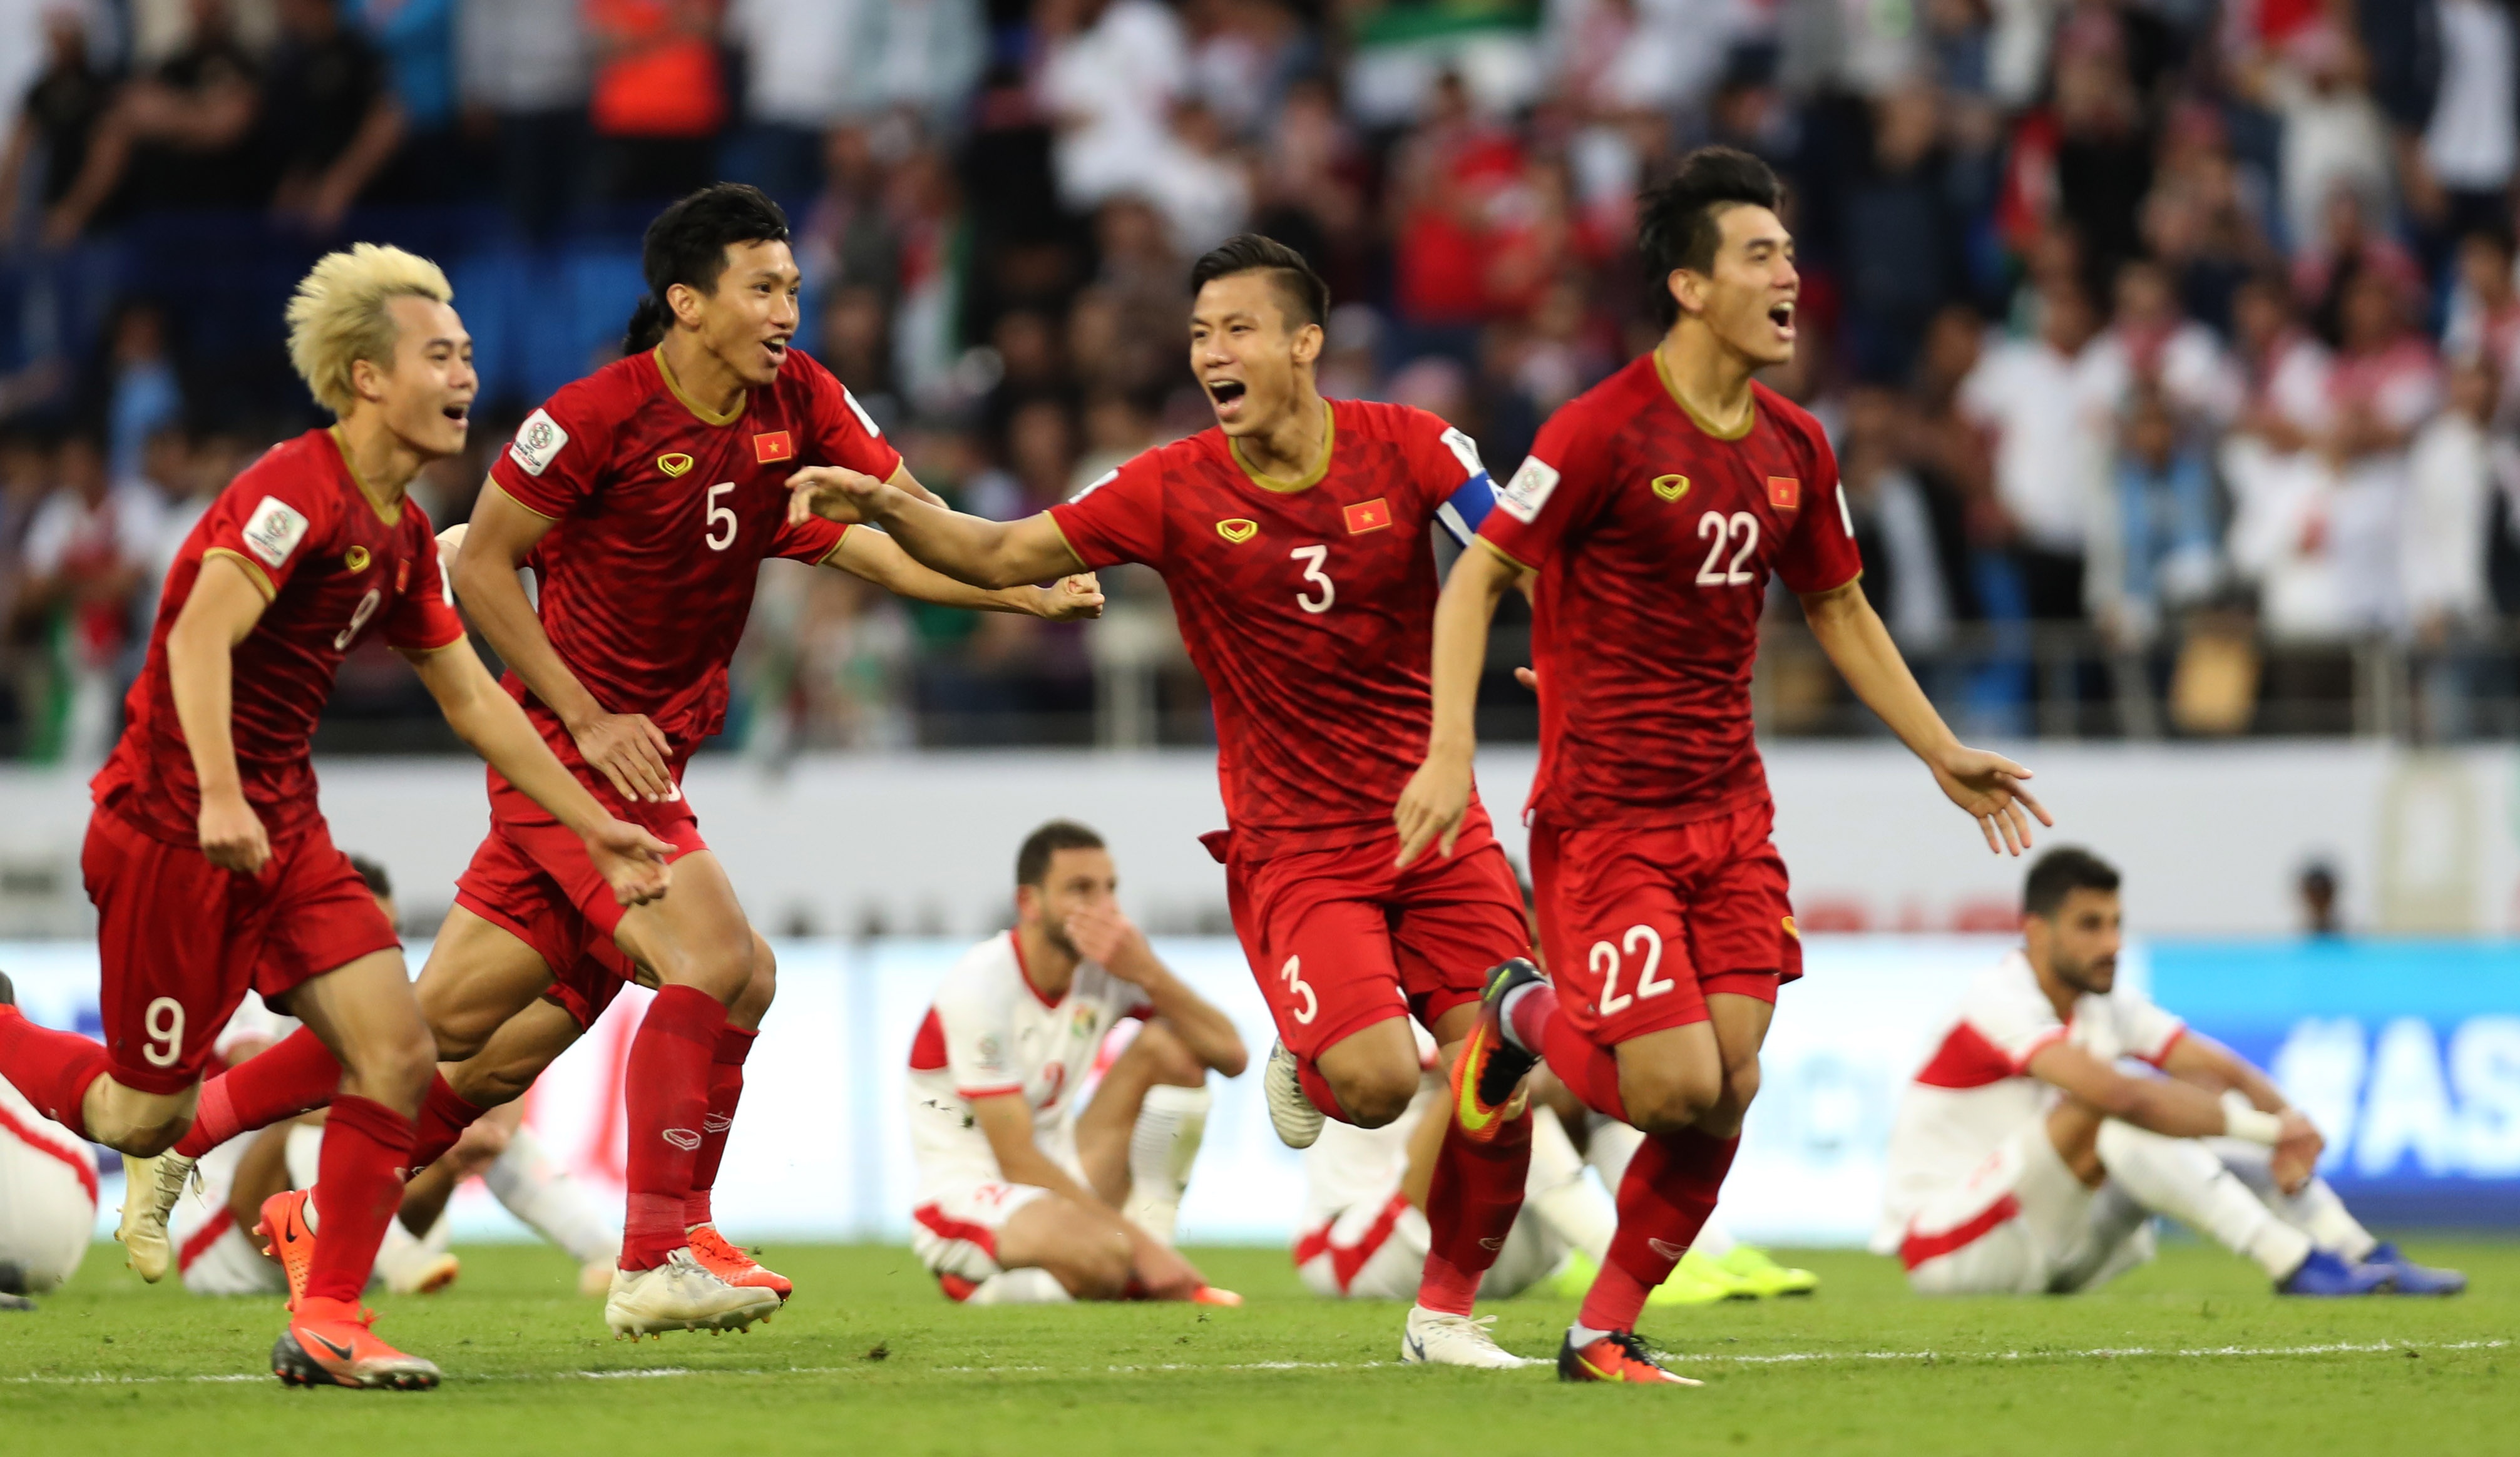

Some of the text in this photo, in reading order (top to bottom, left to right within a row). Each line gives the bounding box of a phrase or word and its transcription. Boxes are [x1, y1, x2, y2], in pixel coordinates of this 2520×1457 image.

[705, 481, 738, 551] 5
[1695, 511, 1759, 586] 22
[1290, 544, 1335, 614] 3
[334, 588, 381, 651] 9
[1281, 954, 1318, 1025] 3
[1588, 924, 1674, 1016] 22
[142, 996, 187, 1067] 9
